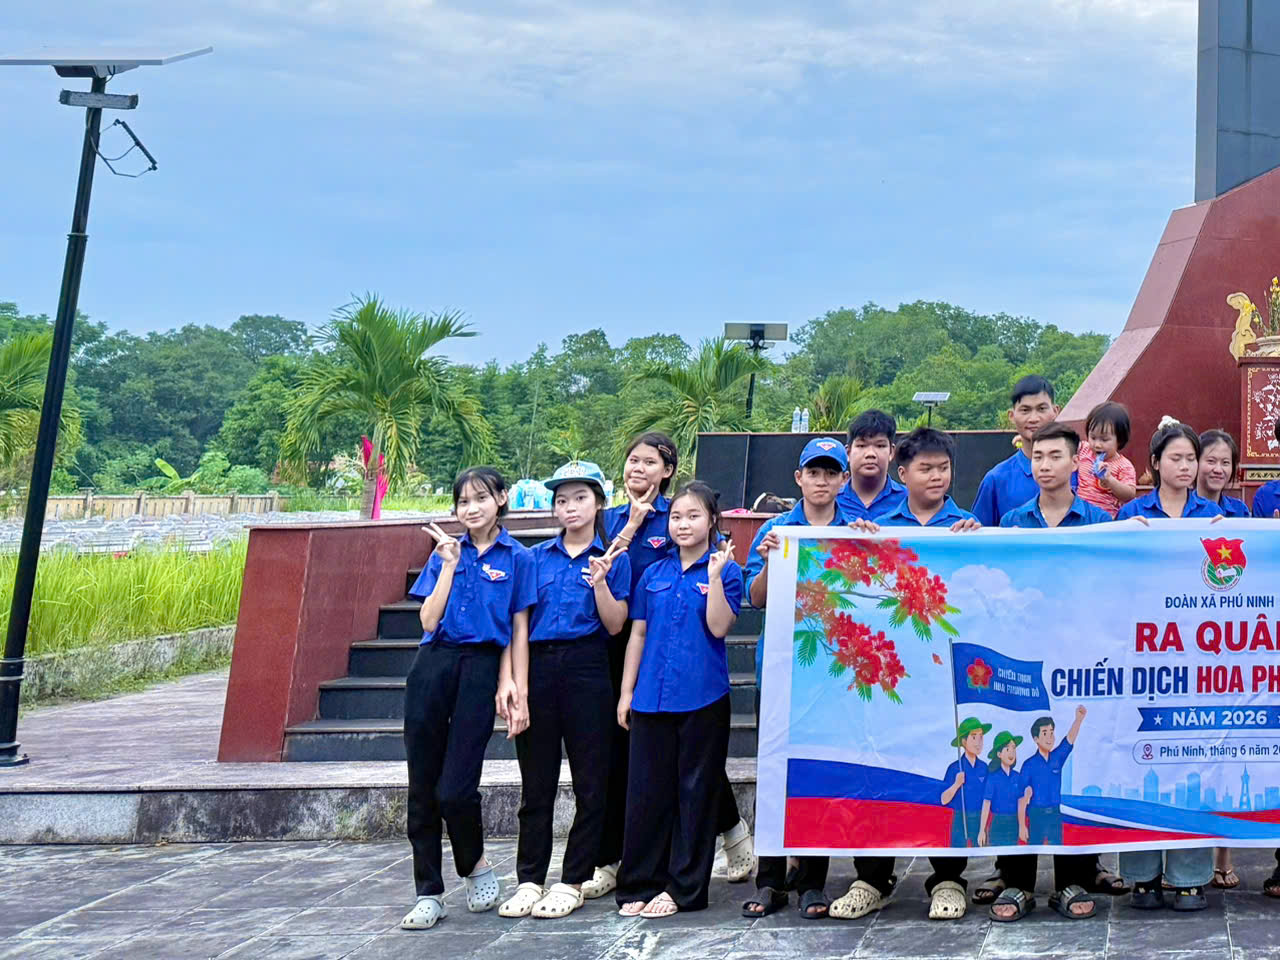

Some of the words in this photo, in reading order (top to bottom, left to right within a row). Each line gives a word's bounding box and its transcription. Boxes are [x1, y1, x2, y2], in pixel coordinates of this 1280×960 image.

[1165, 593, 1198, 609] ĐOÀN
[1201, 593, 1217, 609] XÃ
[1220, 593, 1243, 608] PHÚ
[1246, 595, 1274, 608] NINH
[1135, 622, 1184, 652] RA
[1051, 658, 1124, 697] CHIẾN
[1132, 665, 1188, 701] DỊCH
[1196, 665, 1244, 694] HOA
[1172, 708, 1216, 727] NĂM
[1221, 710, 1268, 726] 2026
[1160, 746, 1179, 758] Phú
[1182, 745, 1208, 758] Ninh,
[1210, 745, 1238, 758] tháng
[1240, 745, 1247, 756] 6
[1249, 744, 1270, 756] năm
